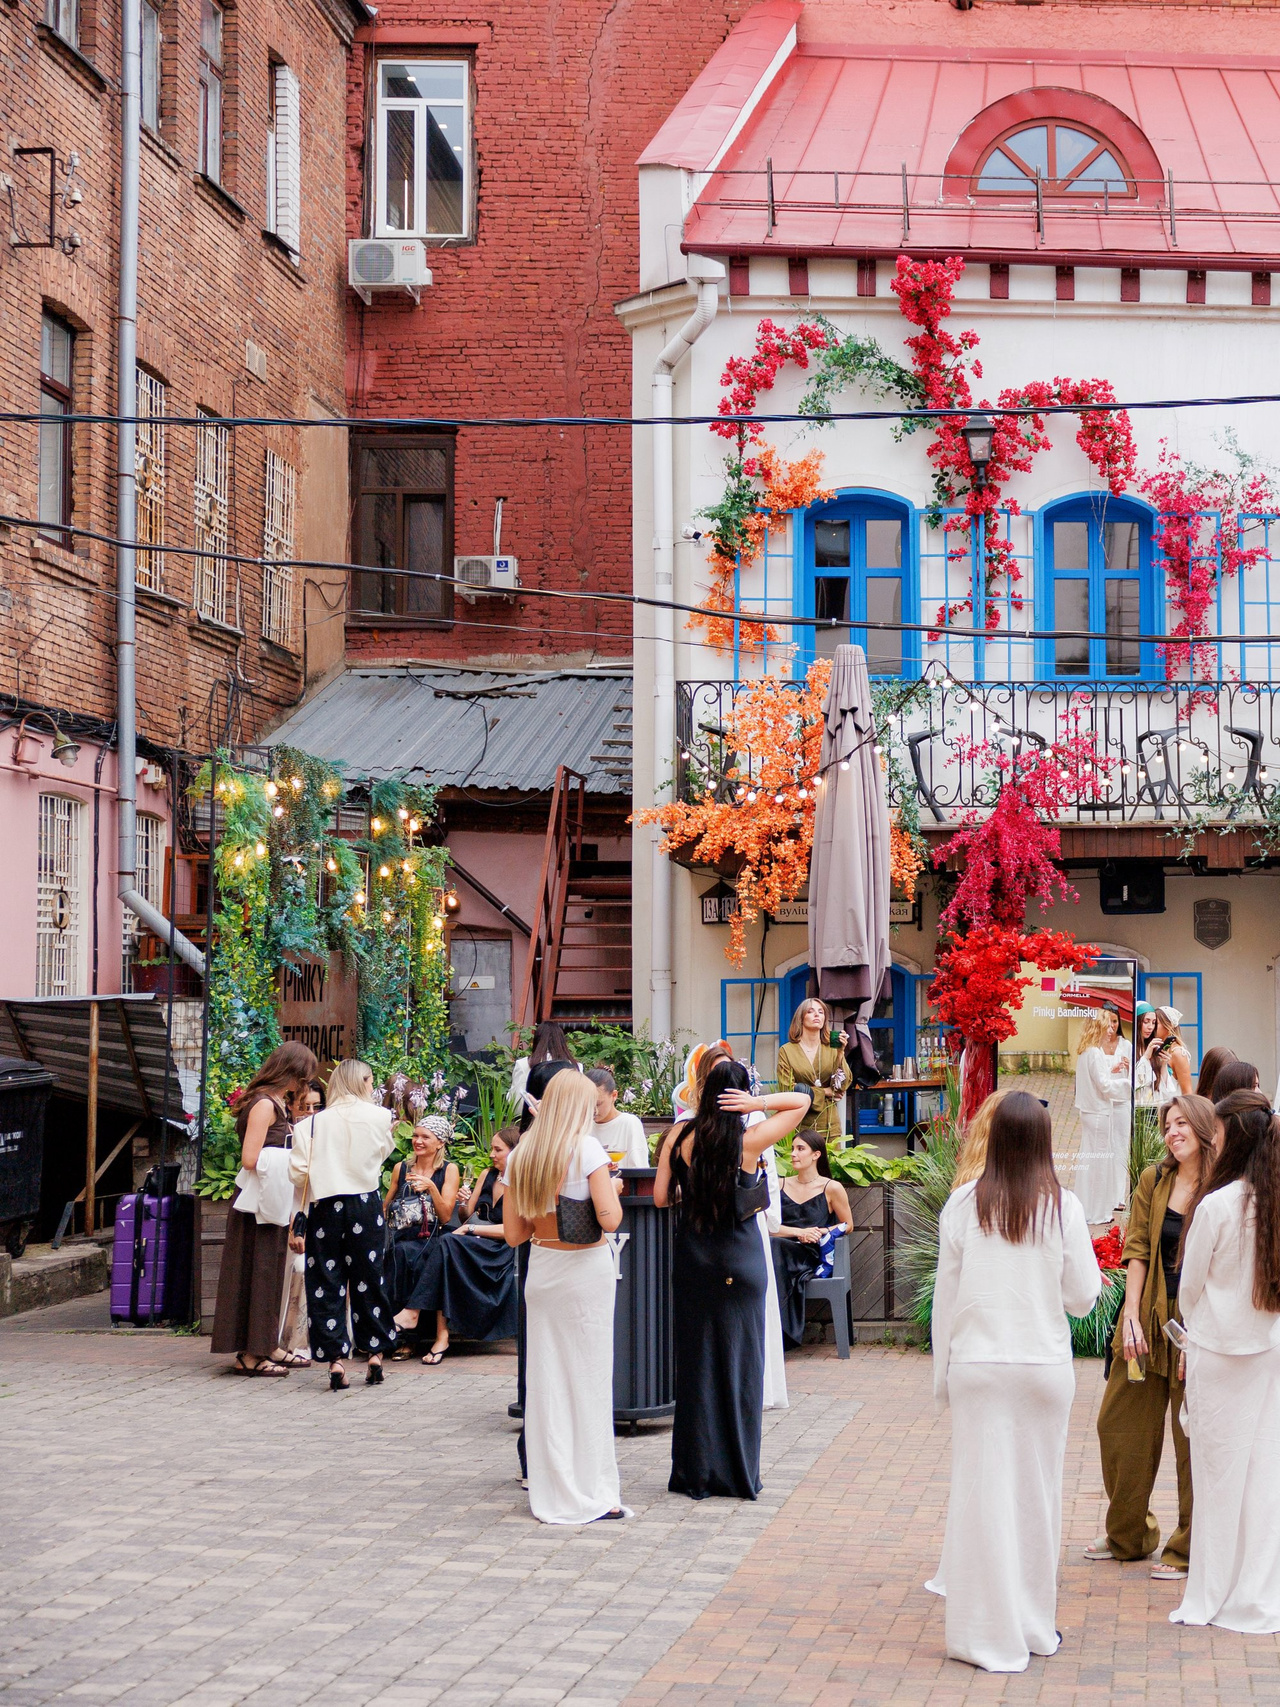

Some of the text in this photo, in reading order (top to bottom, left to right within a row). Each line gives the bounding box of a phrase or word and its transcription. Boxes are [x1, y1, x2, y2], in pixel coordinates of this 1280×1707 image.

[780, 905, 908, 918] вуліц кая
[283, 963, 326, 1002] PINKY
[1033, 1006, 1098, 1020] Pinky Bandinsky
[604, 1233, 630, 1280] Y
